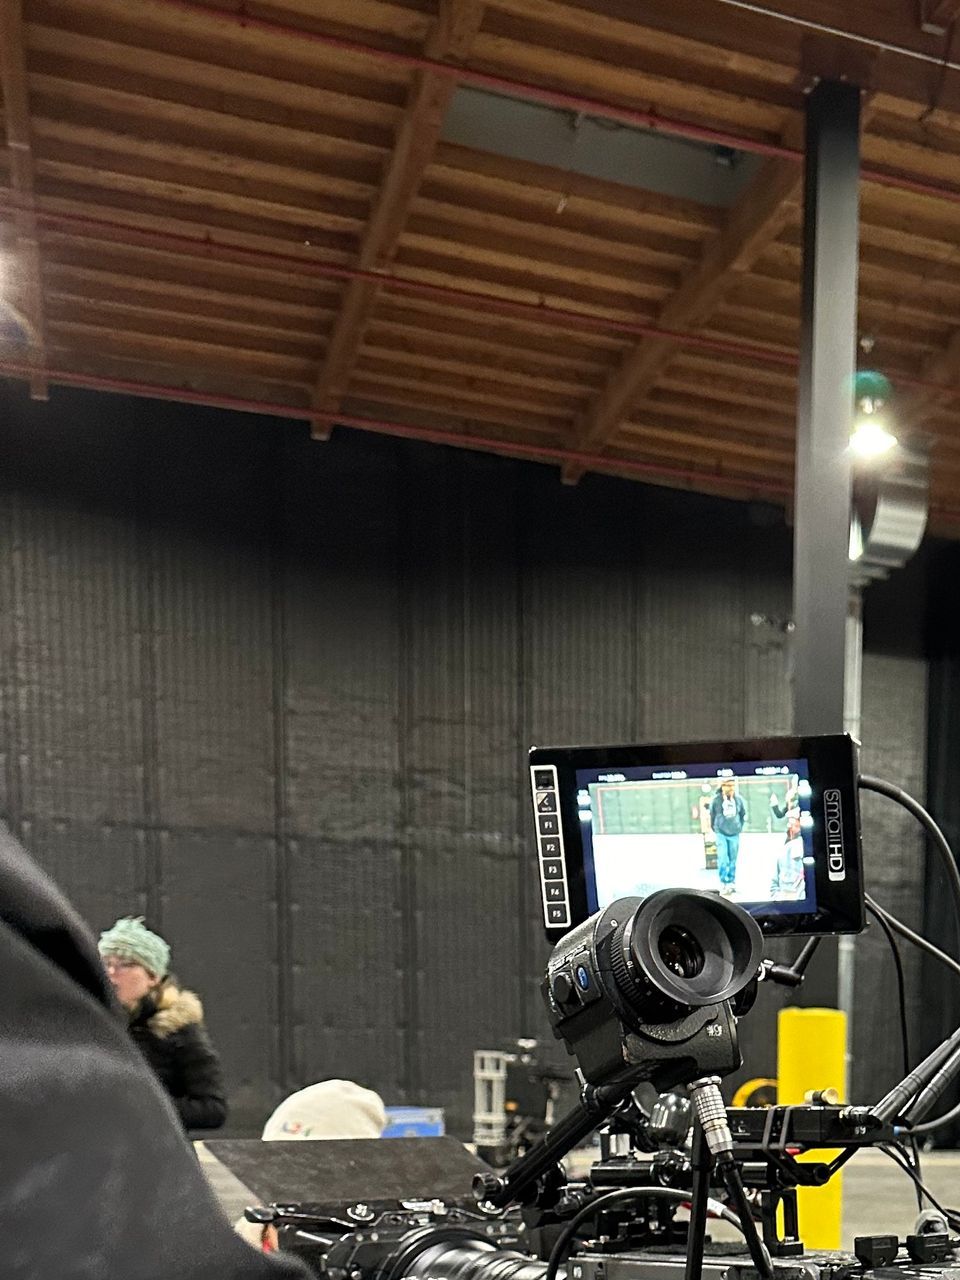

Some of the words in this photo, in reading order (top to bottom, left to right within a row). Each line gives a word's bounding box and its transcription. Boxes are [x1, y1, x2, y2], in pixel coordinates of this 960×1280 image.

[544, 821, 553, 829] F1
[546, 844, 556, 852] F2
[548, 866, 558, 874] F3
[550, 888, 560, 896] F4
[552, 910, 562, 918] F5
